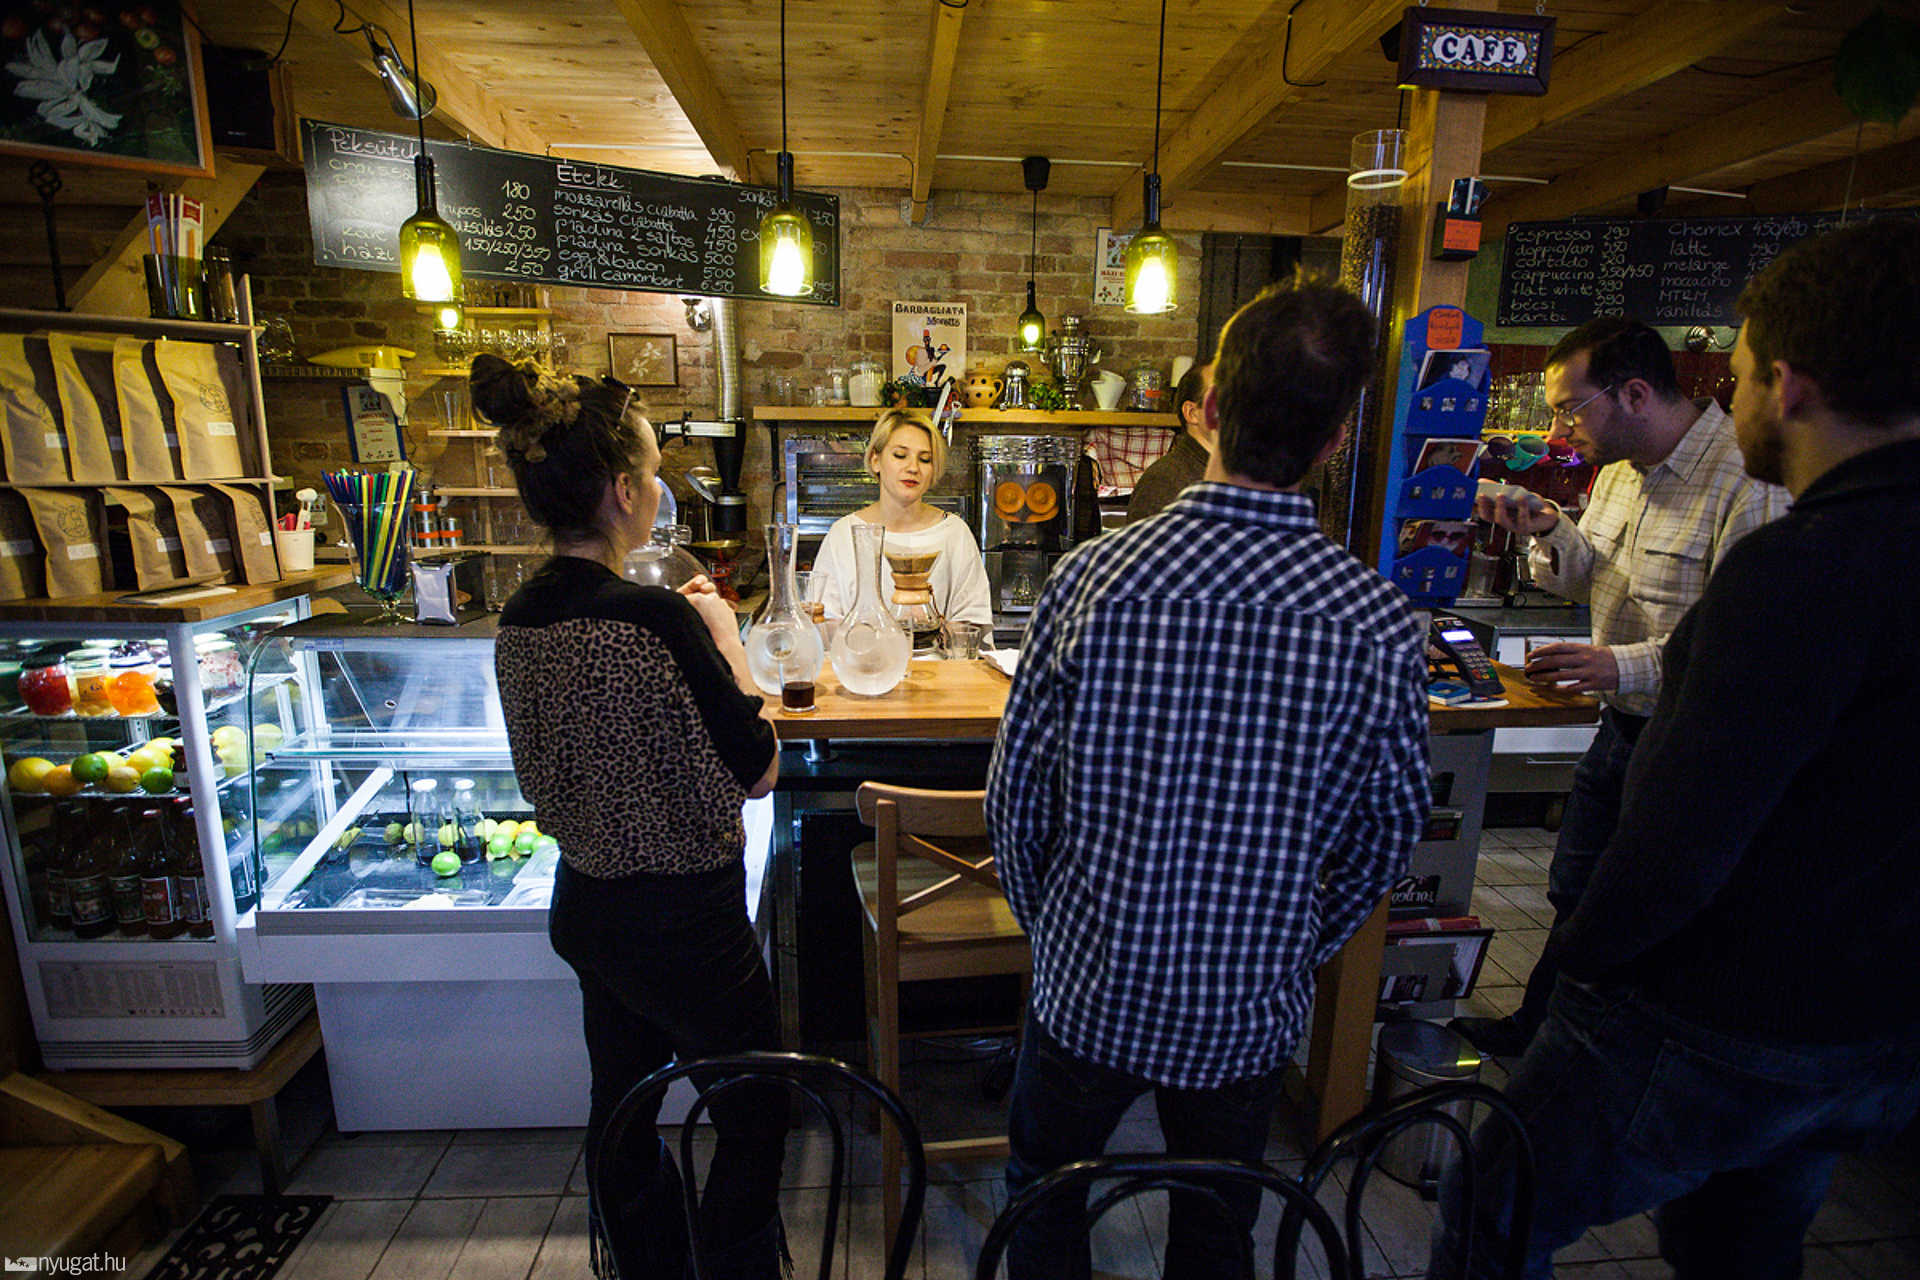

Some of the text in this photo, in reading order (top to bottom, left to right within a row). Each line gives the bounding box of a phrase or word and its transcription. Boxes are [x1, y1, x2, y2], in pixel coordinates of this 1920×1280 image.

[1441, 37, 1518, 62] CAFE
[501, 180, 530, 200] 180
[502, 203, 537, 221] 250
[706, 207, 736, 224] 390
[453, 217, 537, 240] azsolás 250
[553, 203, 614, 223] sonkás
[706, 222, 736, 240] 450
[555, 218, 625, 240] piadina
[629, 227, 643, 242] 2
[703, 235, 738, 253] 450
[1515, 229, 1592, 244] espresso
[556, 234, 735, 266] piadina sonkás 500
[1670, 239, 1713, 257] latte
[504, 260, 544, 275] 250
[1514, 254, 1588, 268] cortado
[557, 262, 597, 281] grill
[701, 280, 735, 293] 650
[703, 267, 736, 279] 500
[1511, 270, 1595, 285] cappuccino
[1511, 281, 1548, 296] flat
[1552, 282, 1593, 297] white
